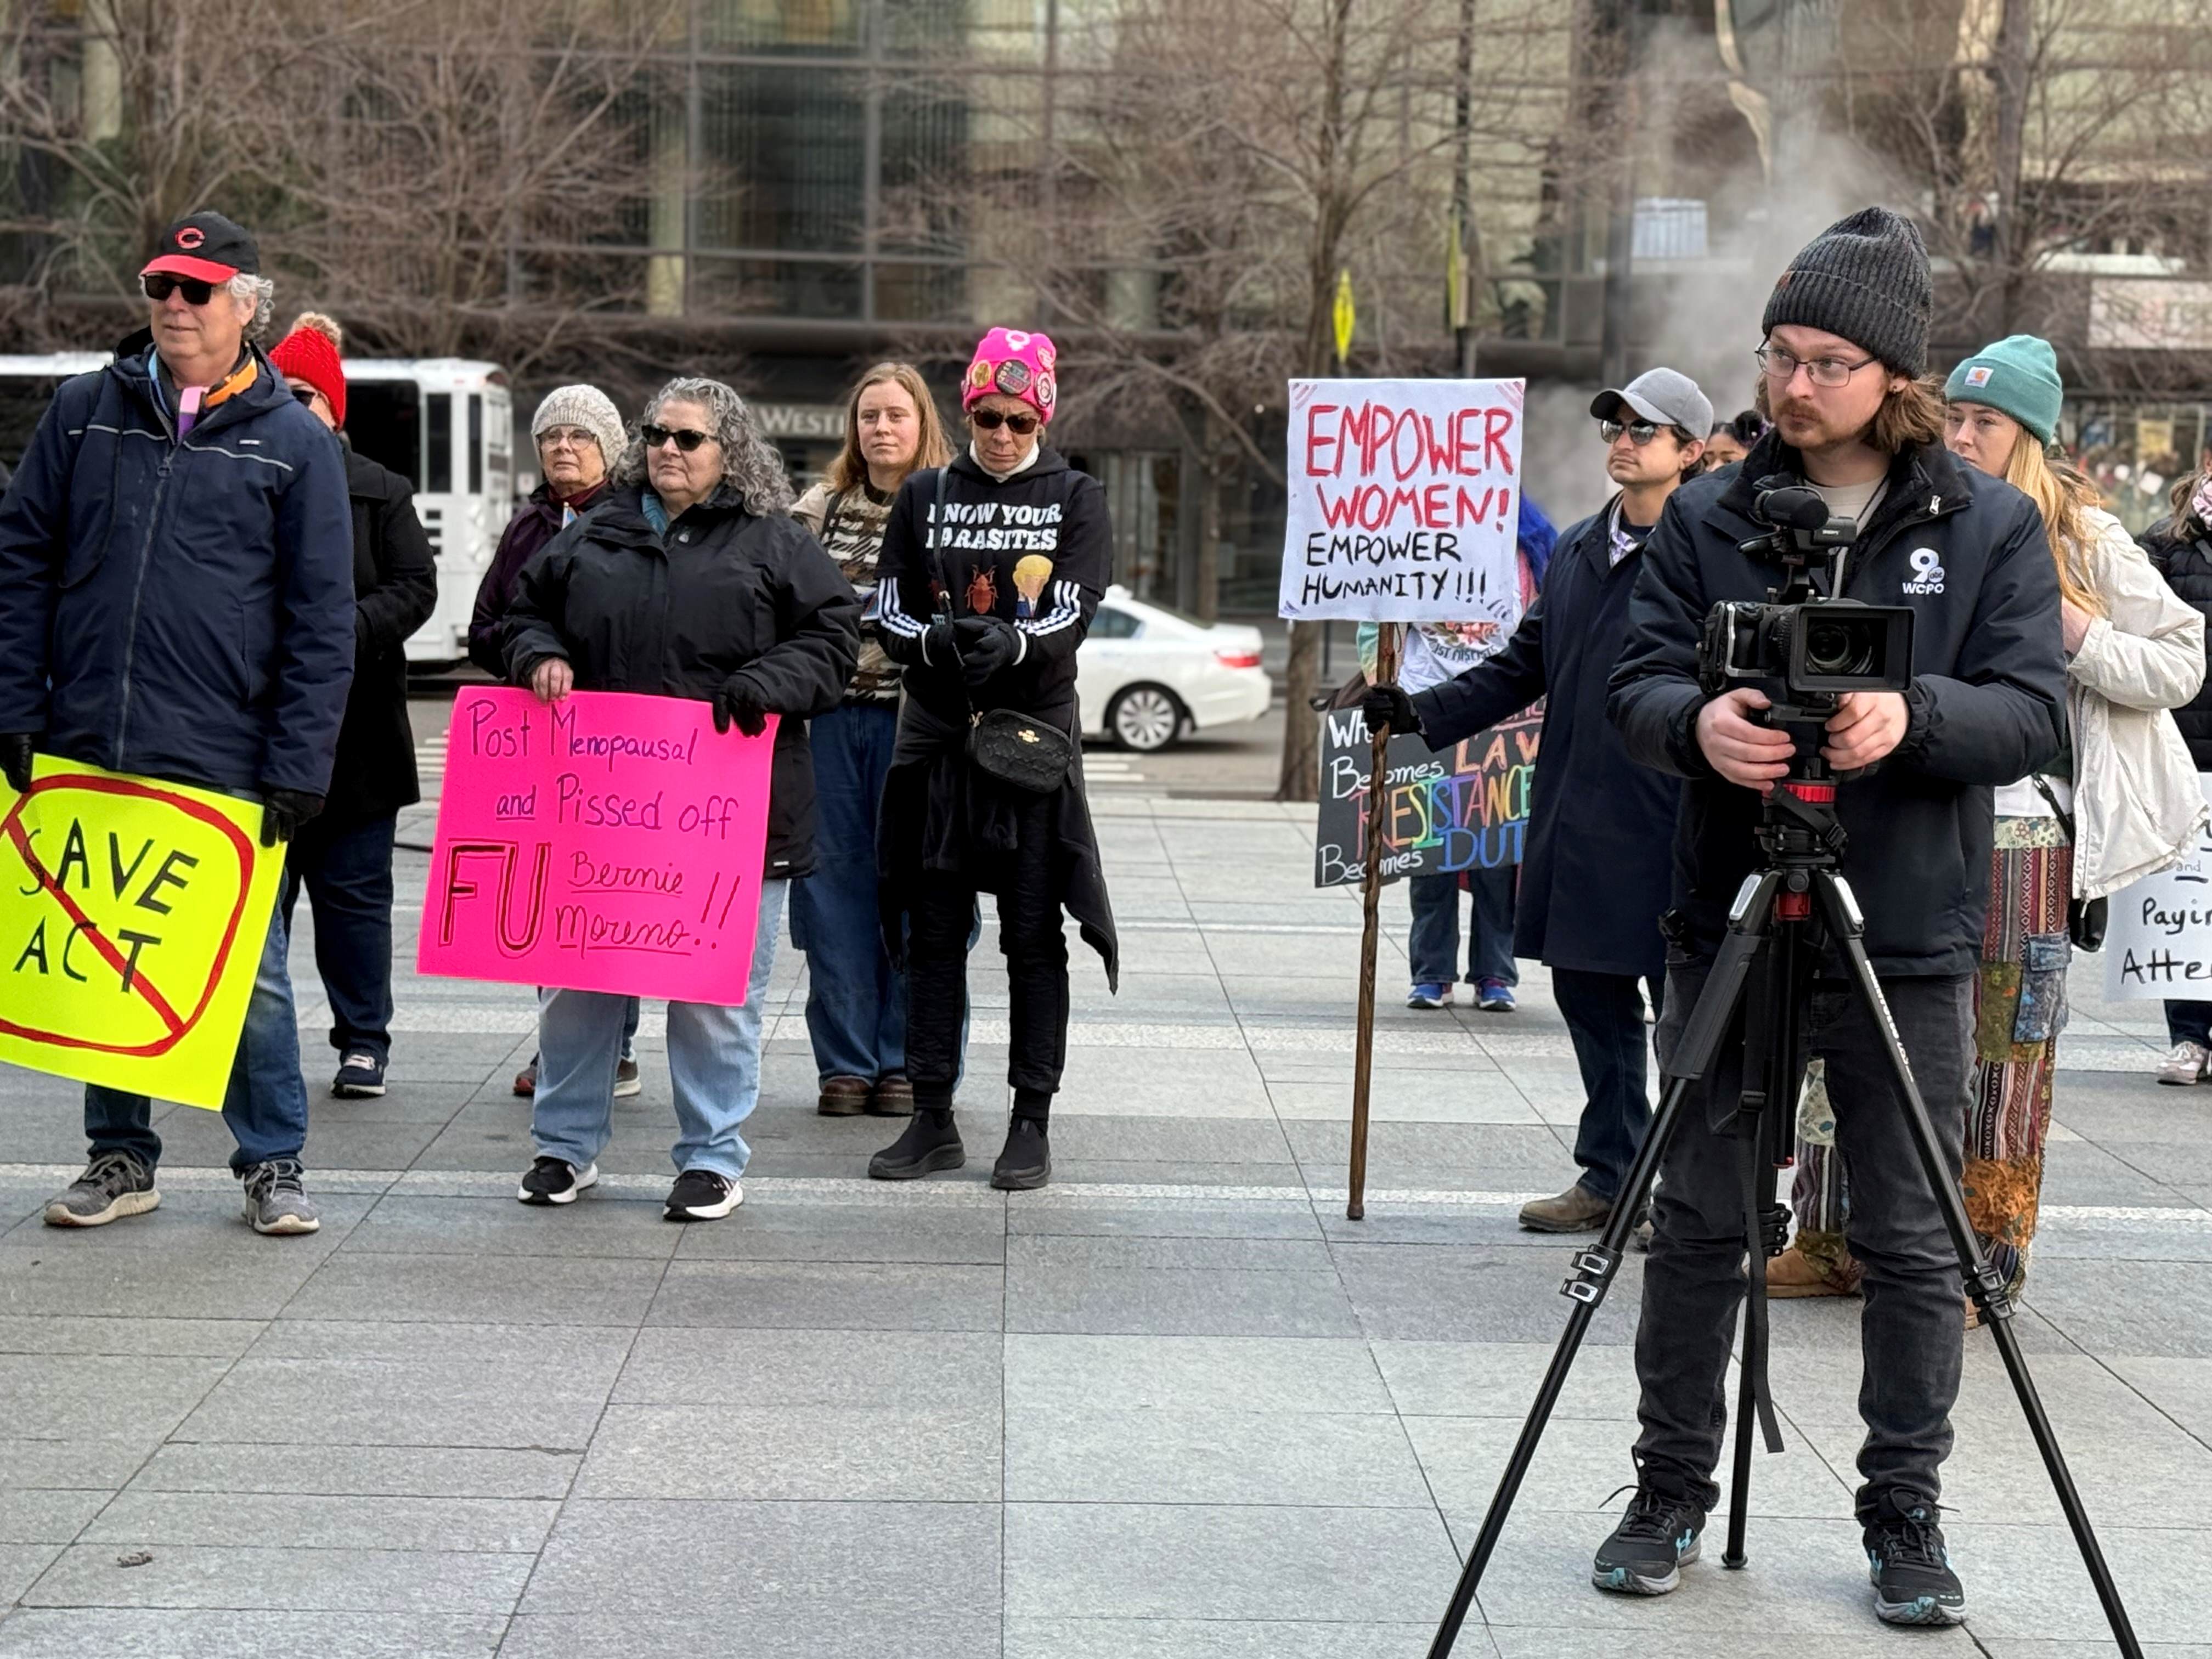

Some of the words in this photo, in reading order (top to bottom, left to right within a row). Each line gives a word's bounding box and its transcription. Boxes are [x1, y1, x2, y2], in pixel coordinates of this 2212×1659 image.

[175, 227, 205, 249] C
[759, 407, 844, 435] WESTI
[1306, 399, 1514, 482] EMPOWER
[1001, 503, 1063, 526] YOUR
[1316, 483, 1510, 534] WOMEN!
[1306, 532, 1462, 566] EMPOWER
[1910, 548, 1939, 583] 9
[1301, 568, 1486, 605] HUMANITY!!!
[1902, 583, 1944, 595] WCPO
[467, 699, 531, 757] Post
[551, 704, 698, 772] Menopausal
[496, 785, 536, 815] and
[557, 772, 663, 830] Pissed
[679, 795, 738, 839] off
[1319, 844, 1423, 885] Becmes
[1437, 819, 1529, 871] DUT
[19, 817, 200, 915] SAVE
[2176, 860, 2201, 872] and
[439, 838, 552, 959] FU
[568, 850, 683, 894] Bernie
[13, 915, 162, 994] ACT
[2121, 948, 2212, 984] Atte
